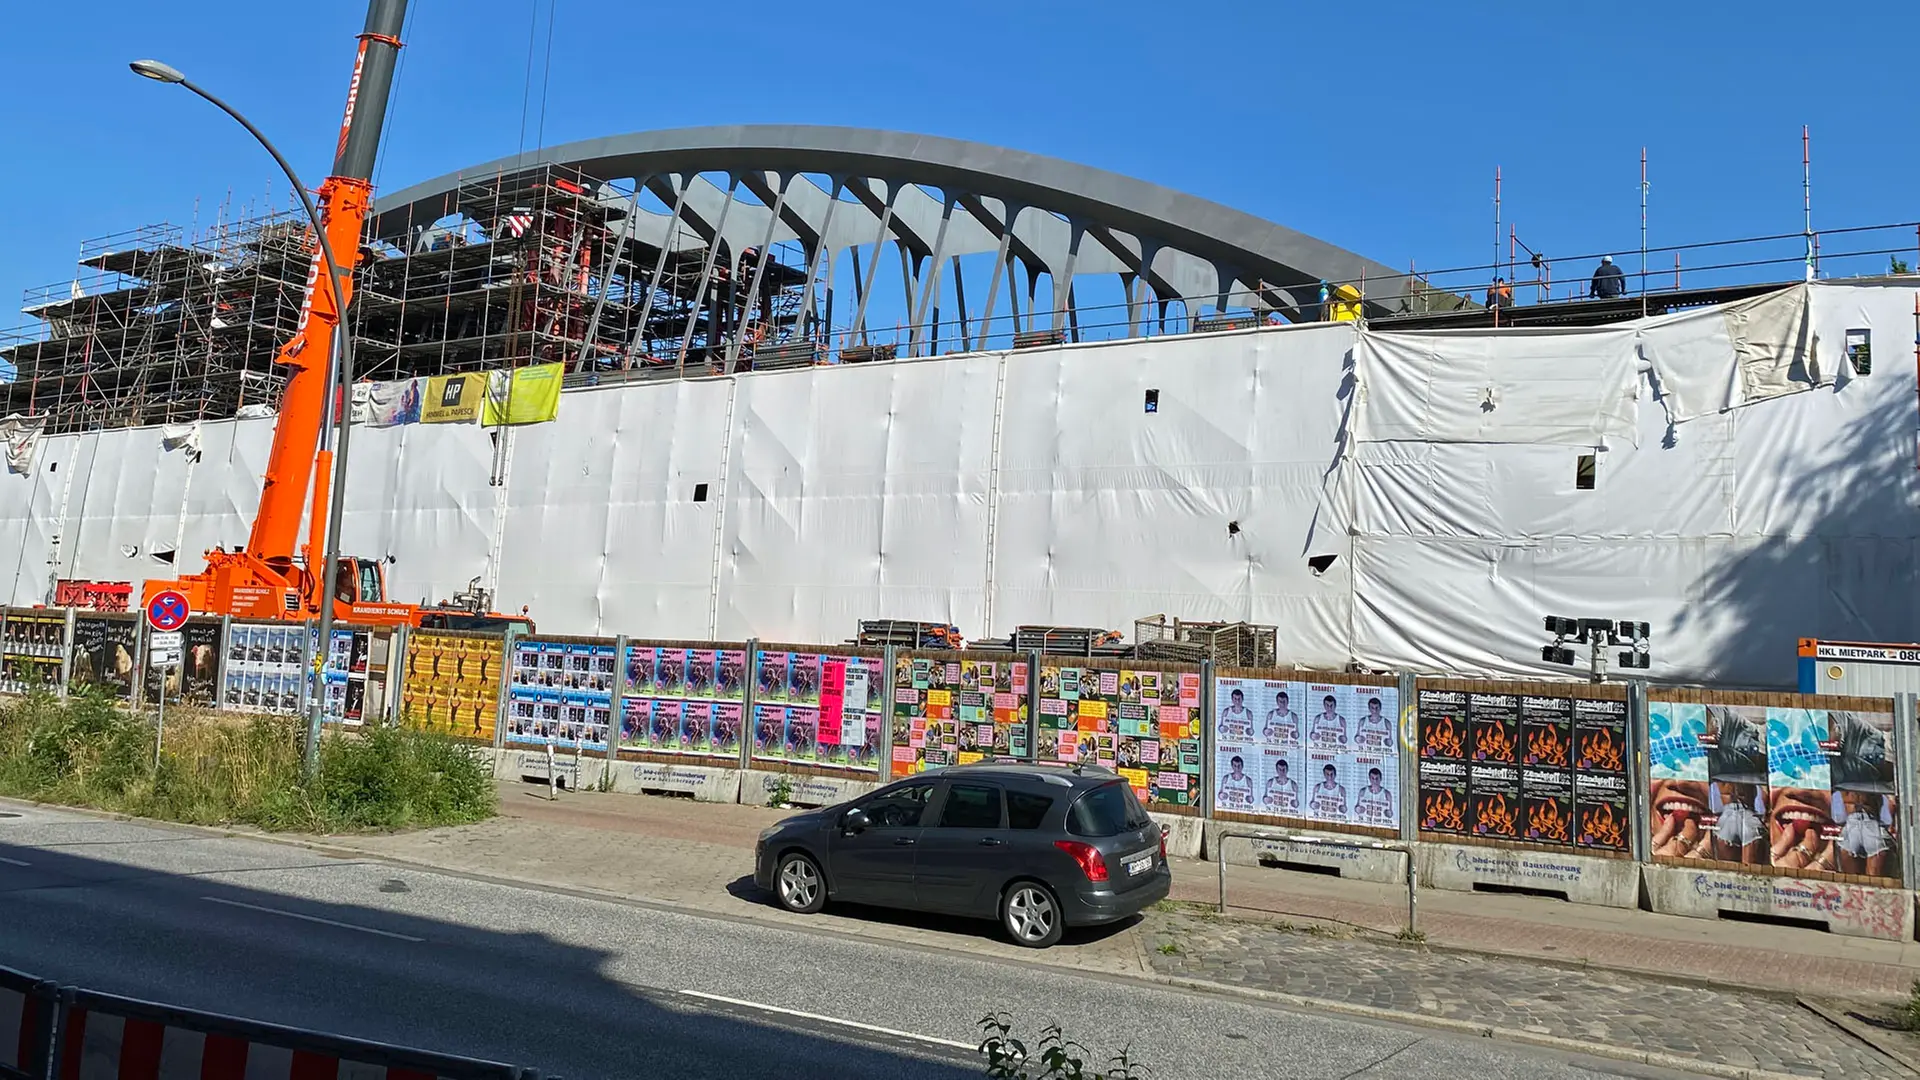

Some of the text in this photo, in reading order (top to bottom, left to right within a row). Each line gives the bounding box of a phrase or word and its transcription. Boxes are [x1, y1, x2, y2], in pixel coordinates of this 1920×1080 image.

[343, 50, 366, 127] SCHULZ
[444, 383, 461, 400] HP
[352, 606, 410, 616] KRANDIENST SCHULZ
[1818, 648, 1837, 656] HKL
[1839, 648, 1886, 658] MIETPARK
[1420, 691, 1456, 703] Zündstoff
[1471, 694, 1507, 706] Zündstoff
[1523, 697, 1560, 709] Zündstoff
[1576, 700, 1614, 712] Zündstoff
[1420, 762, 1456, 774] Zündstoff
[1472, 766, 1508, 779] Zündstoff
[1523, 770, 1560, 783] Zündstoff
[1577, 774, 1615, 788] Zündstoff
[1523, 861, 1582, 874] Bausicherung
